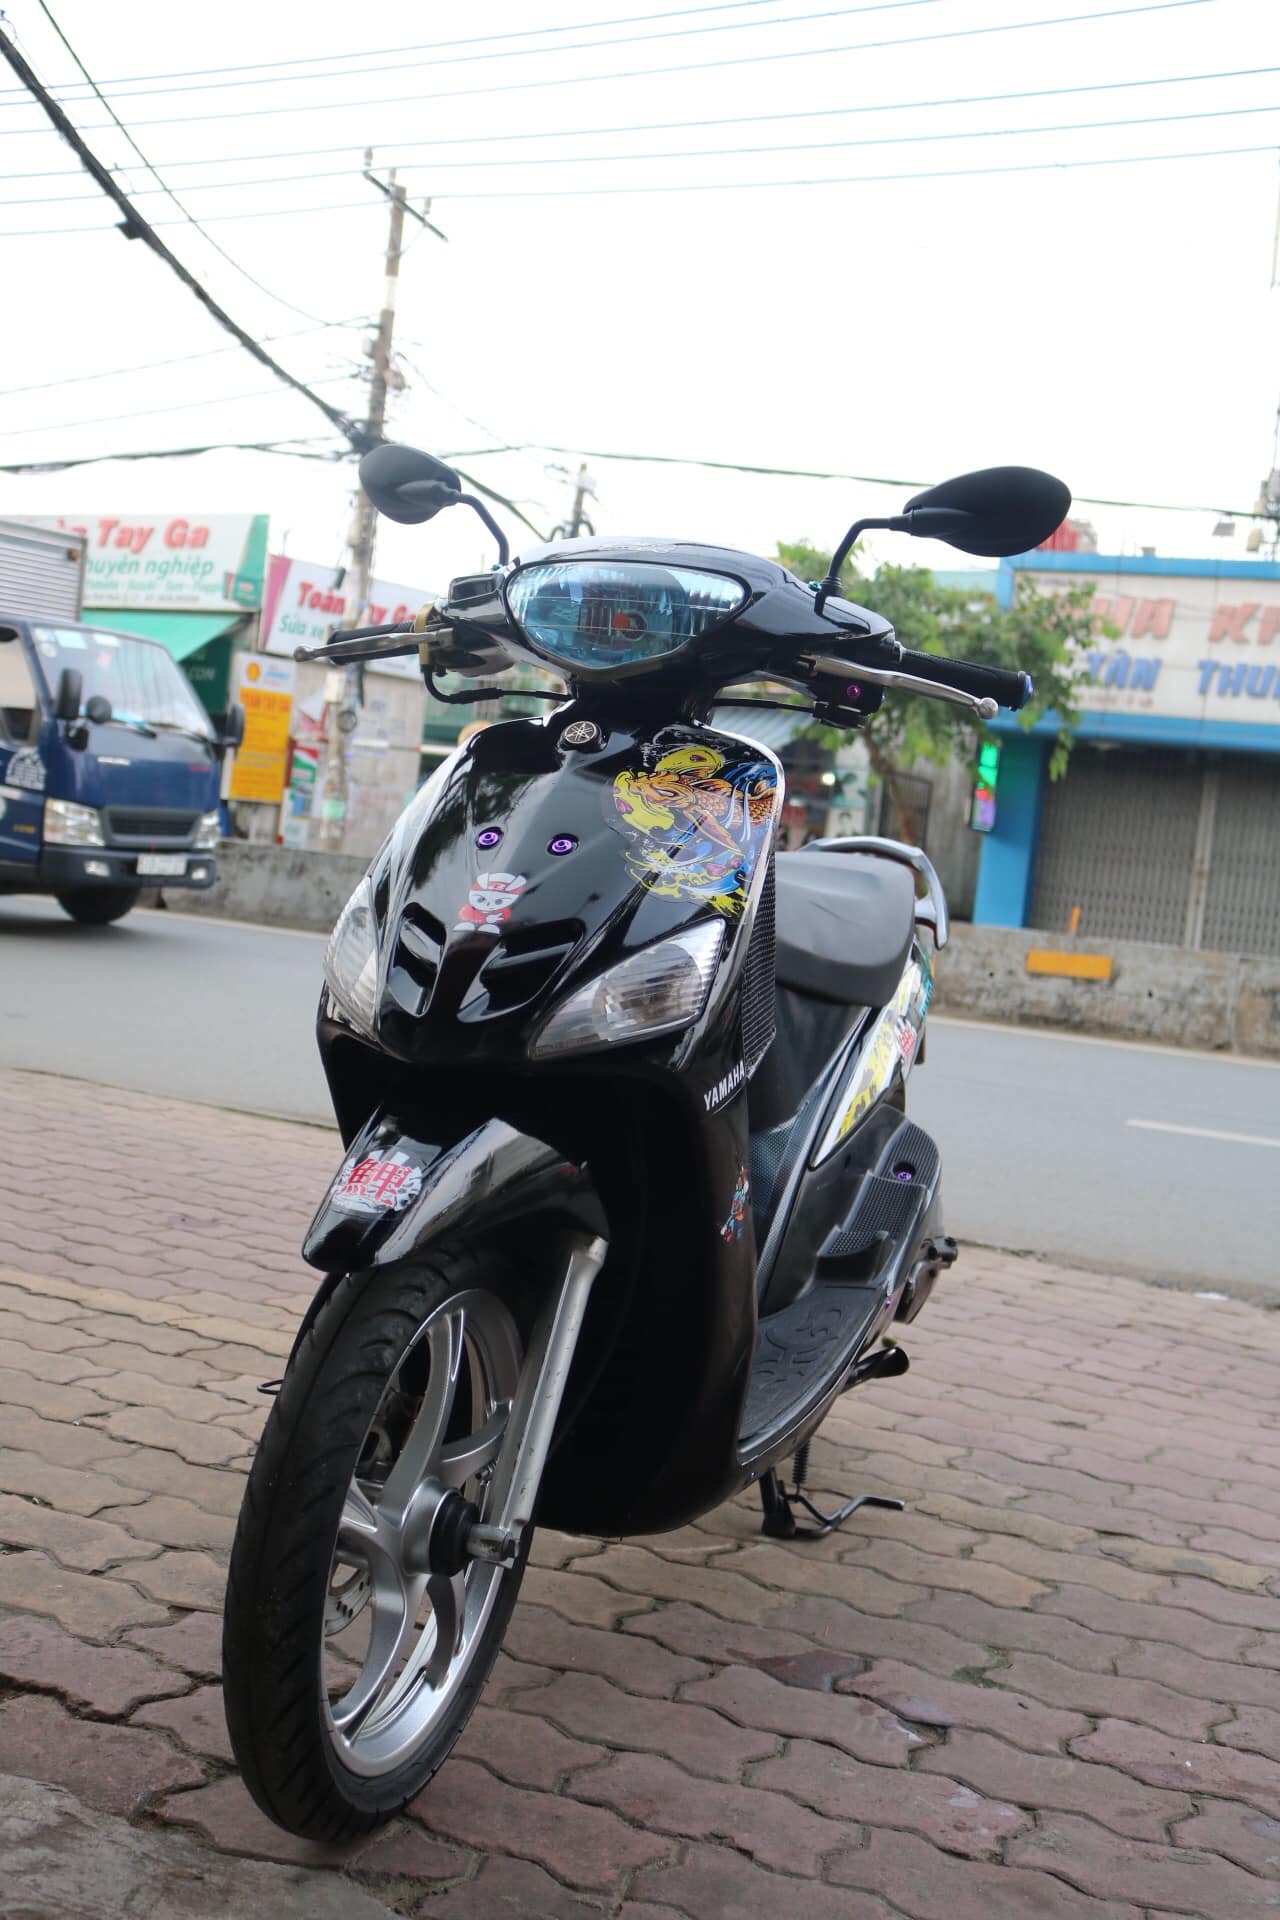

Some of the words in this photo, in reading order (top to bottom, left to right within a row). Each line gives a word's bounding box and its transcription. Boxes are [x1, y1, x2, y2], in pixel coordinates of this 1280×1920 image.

[97, 518, 154, 554] Tay
[163, 517, 210, 549] Ga
[1197, 661, 1280, 698] THU
[703, 1059, 746, 1111] YAMAHA
